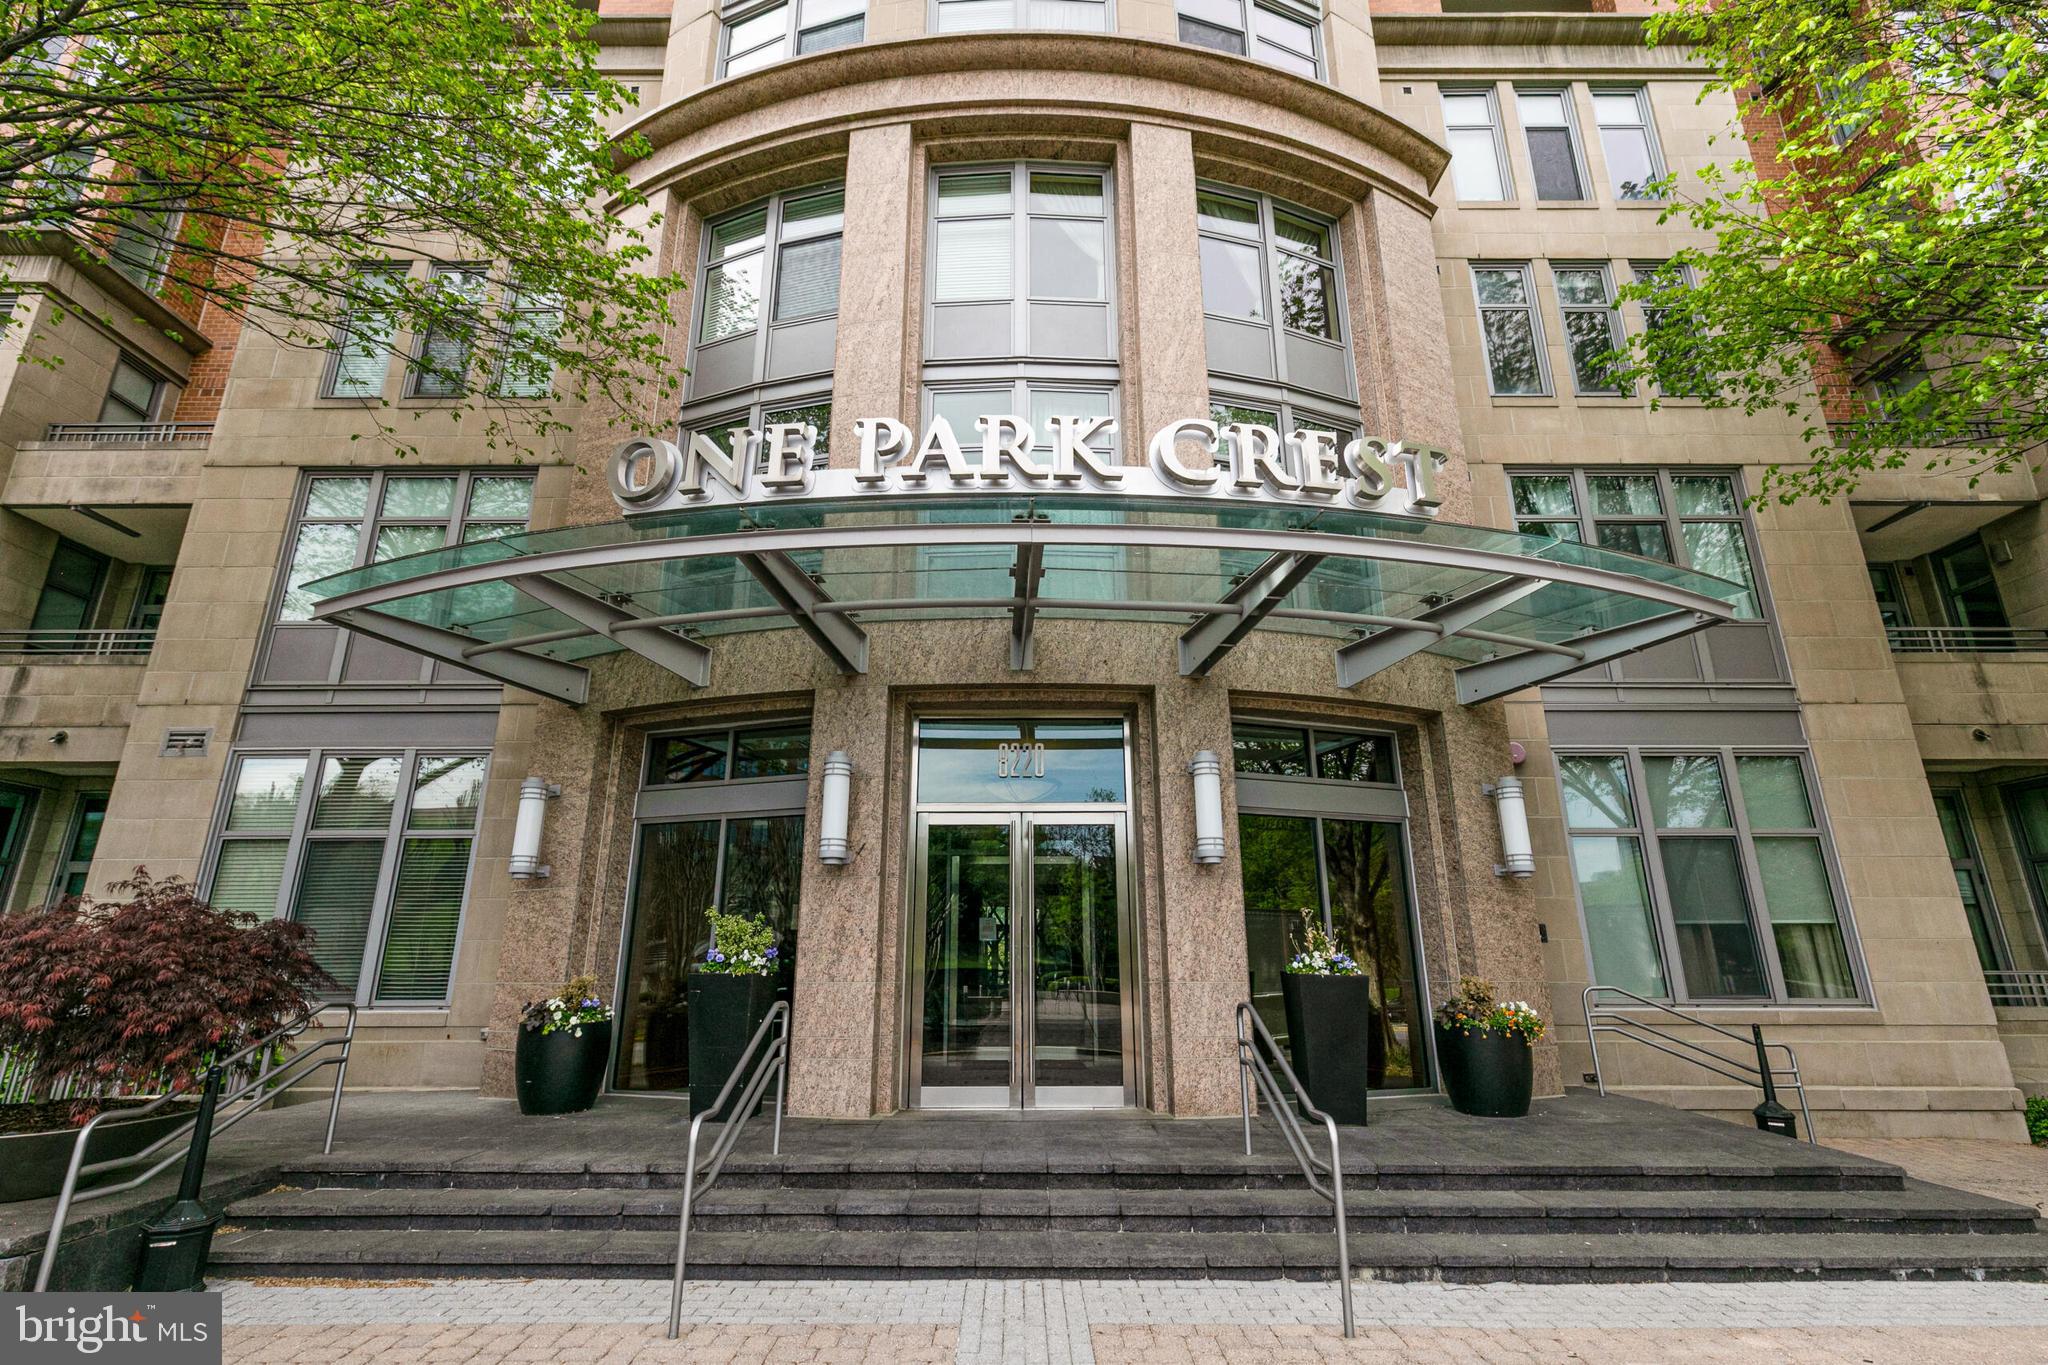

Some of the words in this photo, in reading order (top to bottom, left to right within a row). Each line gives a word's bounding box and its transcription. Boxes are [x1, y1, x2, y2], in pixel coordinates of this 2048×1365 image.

[607, 422, 810, 503] ONE
[853, 414, 1123, 484] PARK
[1155, 420, 1448, 508] CREST
[998, 743, 1045, 778] 8220
